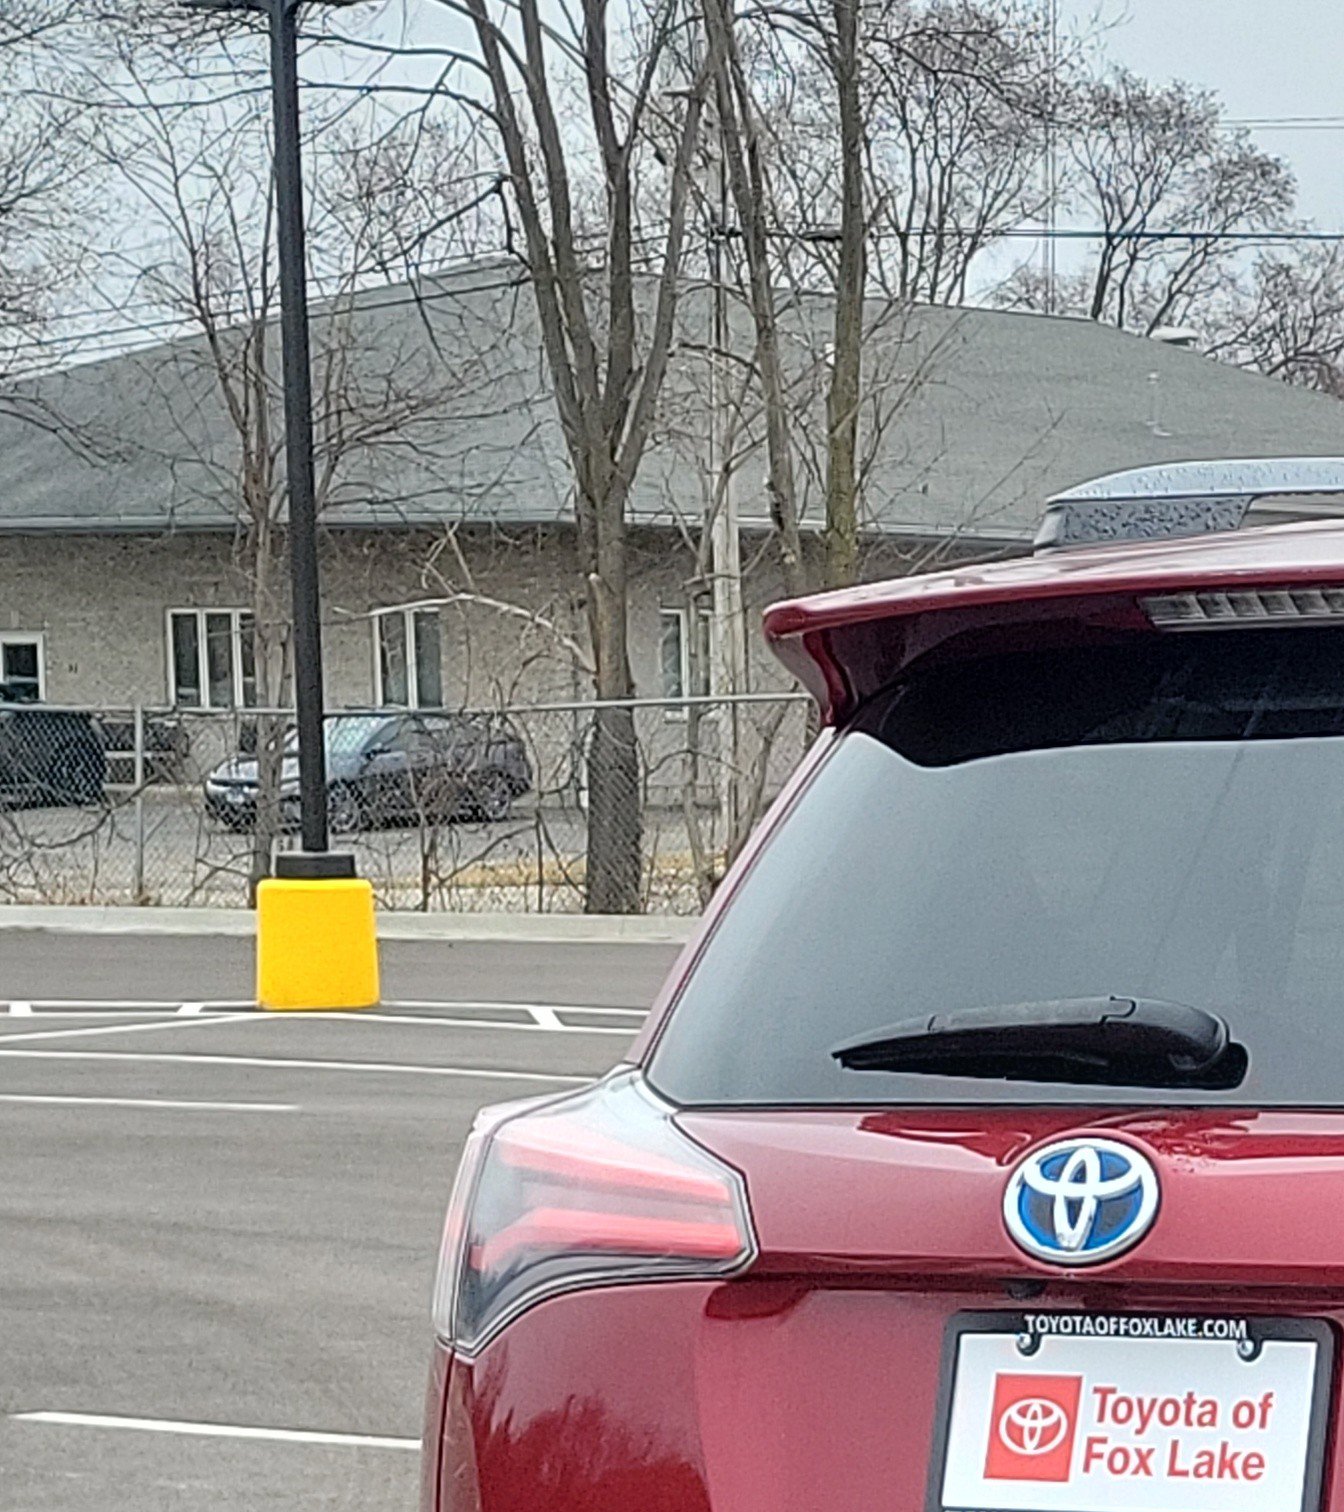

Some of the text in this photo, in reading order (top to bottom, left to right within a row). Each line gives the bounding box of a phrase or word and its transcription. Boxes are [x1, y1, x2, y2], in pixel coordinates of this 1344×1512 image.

[1024, 1314, 1247, 1338] TOYOTAOFFOXLAKE.COM
[1092, 1386, 1275, 1434] Toyota of
[1081, 1436, 1266, 1481] Fox Lake
